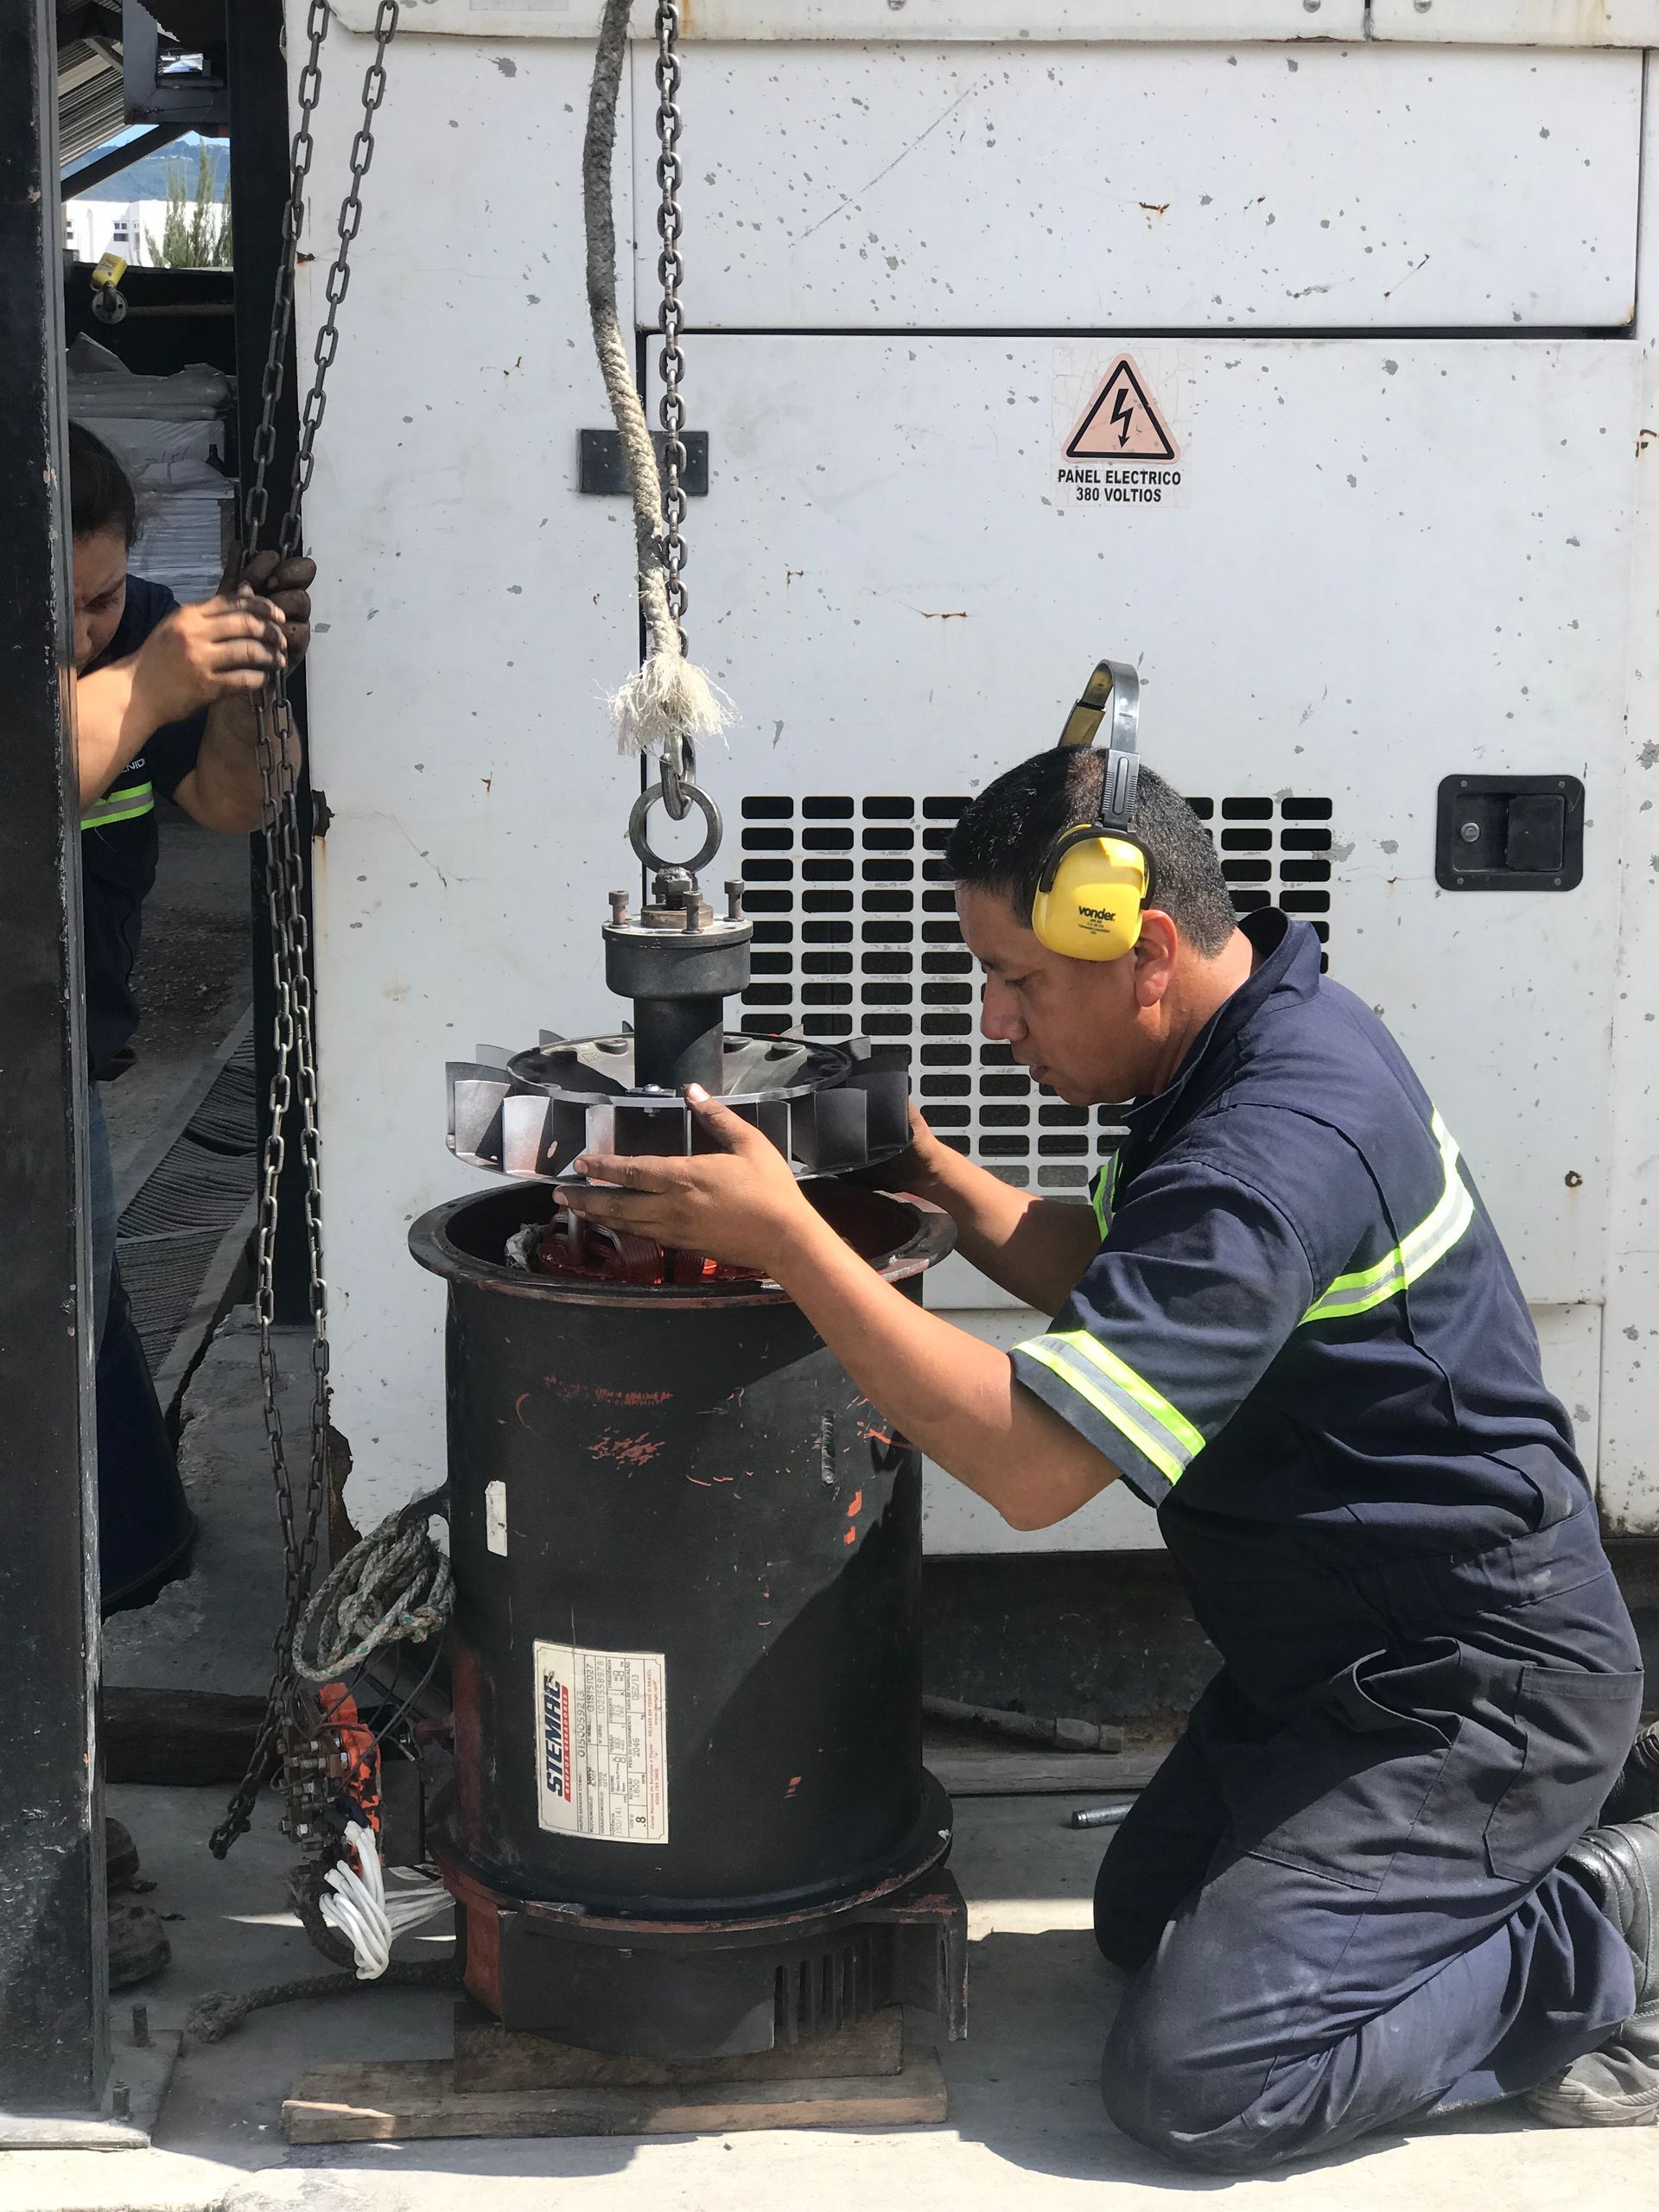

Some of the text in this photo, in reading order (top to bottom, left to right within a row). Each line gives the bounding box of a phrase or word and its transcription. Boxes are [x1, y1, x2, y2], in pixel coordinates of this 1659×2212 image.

[1058, 469, 1181, 485] PANEL ELECTRICO
[1076, 487, 1161, 502] 380 VOLTIOS
[1078, 906, 1116, 921] vonder
[576, 1691, 585, 1758] 0150059213
[543, 1675, 563, 1796] STEMAC
[636, 1816, 646, 1827] .8
